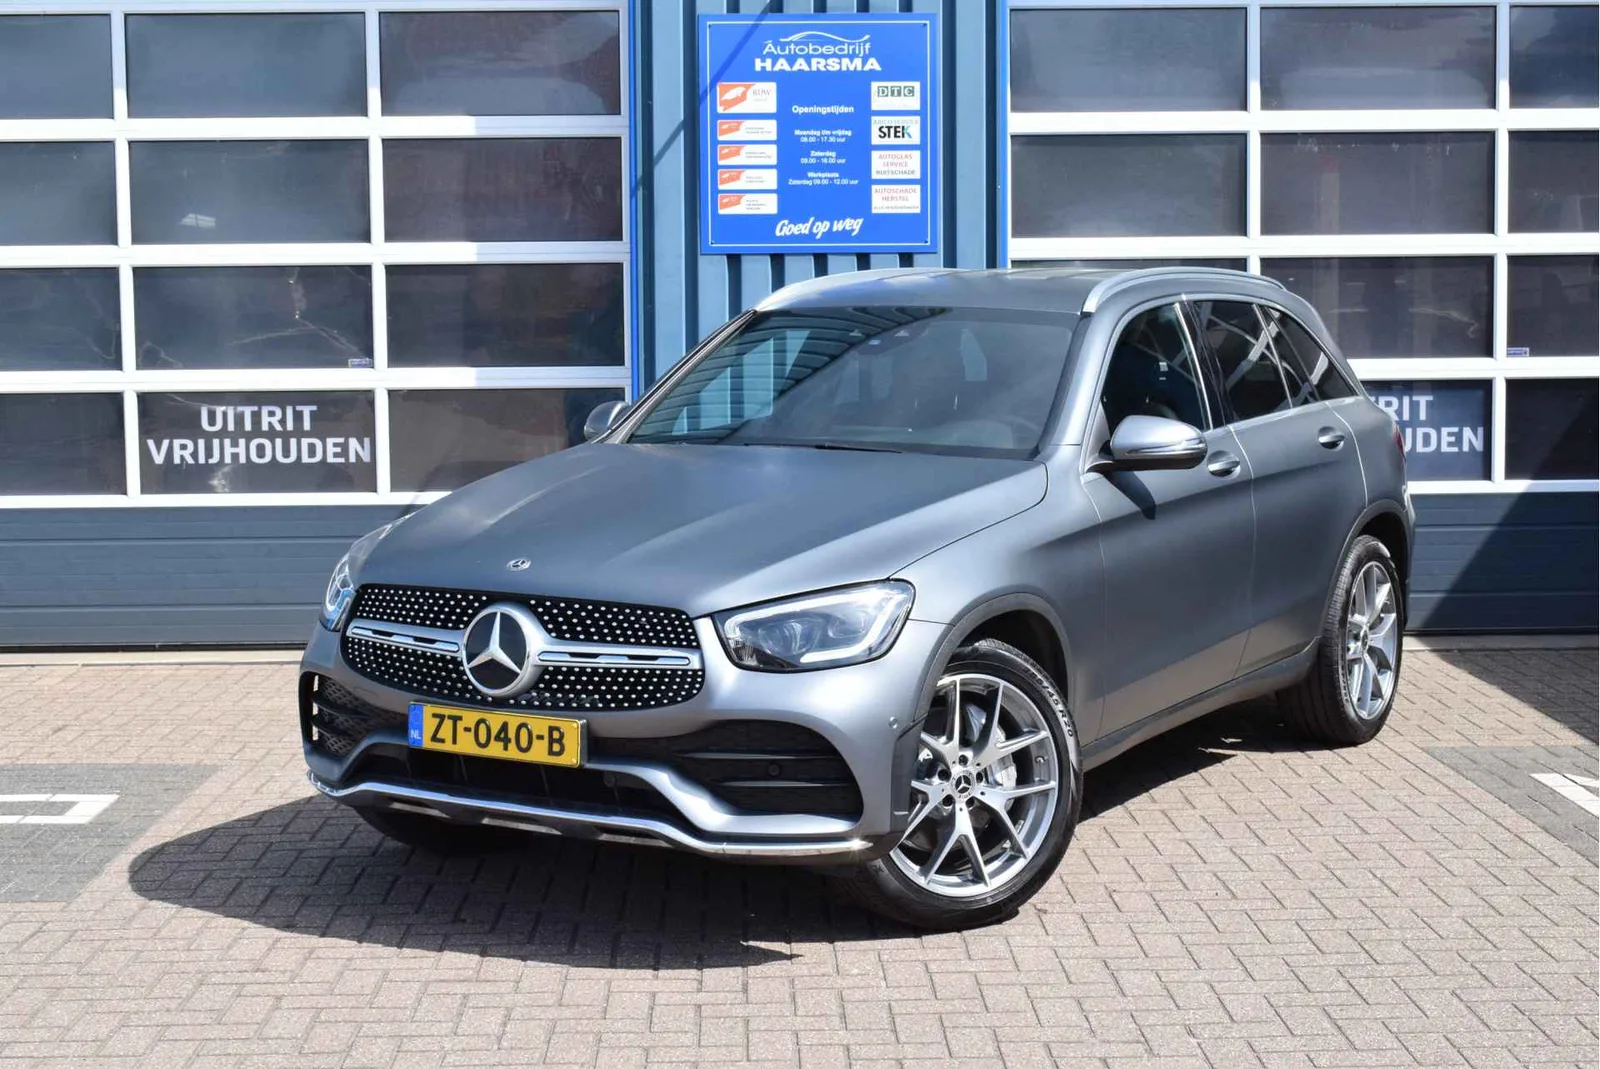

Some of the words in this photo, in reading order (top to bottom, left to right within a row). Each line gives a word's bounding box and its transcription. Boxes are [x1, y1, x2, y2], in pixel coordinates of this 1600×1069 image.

[763, 41, 871, 57] Autobedrijf
[754, 57, 882, 71] HAARSMA
[878, 86, 914, 97] DTC
[791, 105, 854, 115] Openingstijden
[878, 125, 912, 139] STEK
[775, 216, 815, 237] Goed
[812, 220, 831, 239] op
[832, 217, 864, 236] weg
[1371, 395, 1433, 421] RIT
[200, 405, 317, 432] UITRIT
[146, 437, 371, 464] VRIJHOUDEN
[410, 729, 421, 740] NL
[430, 712, 566, 757] ZT-040-B
